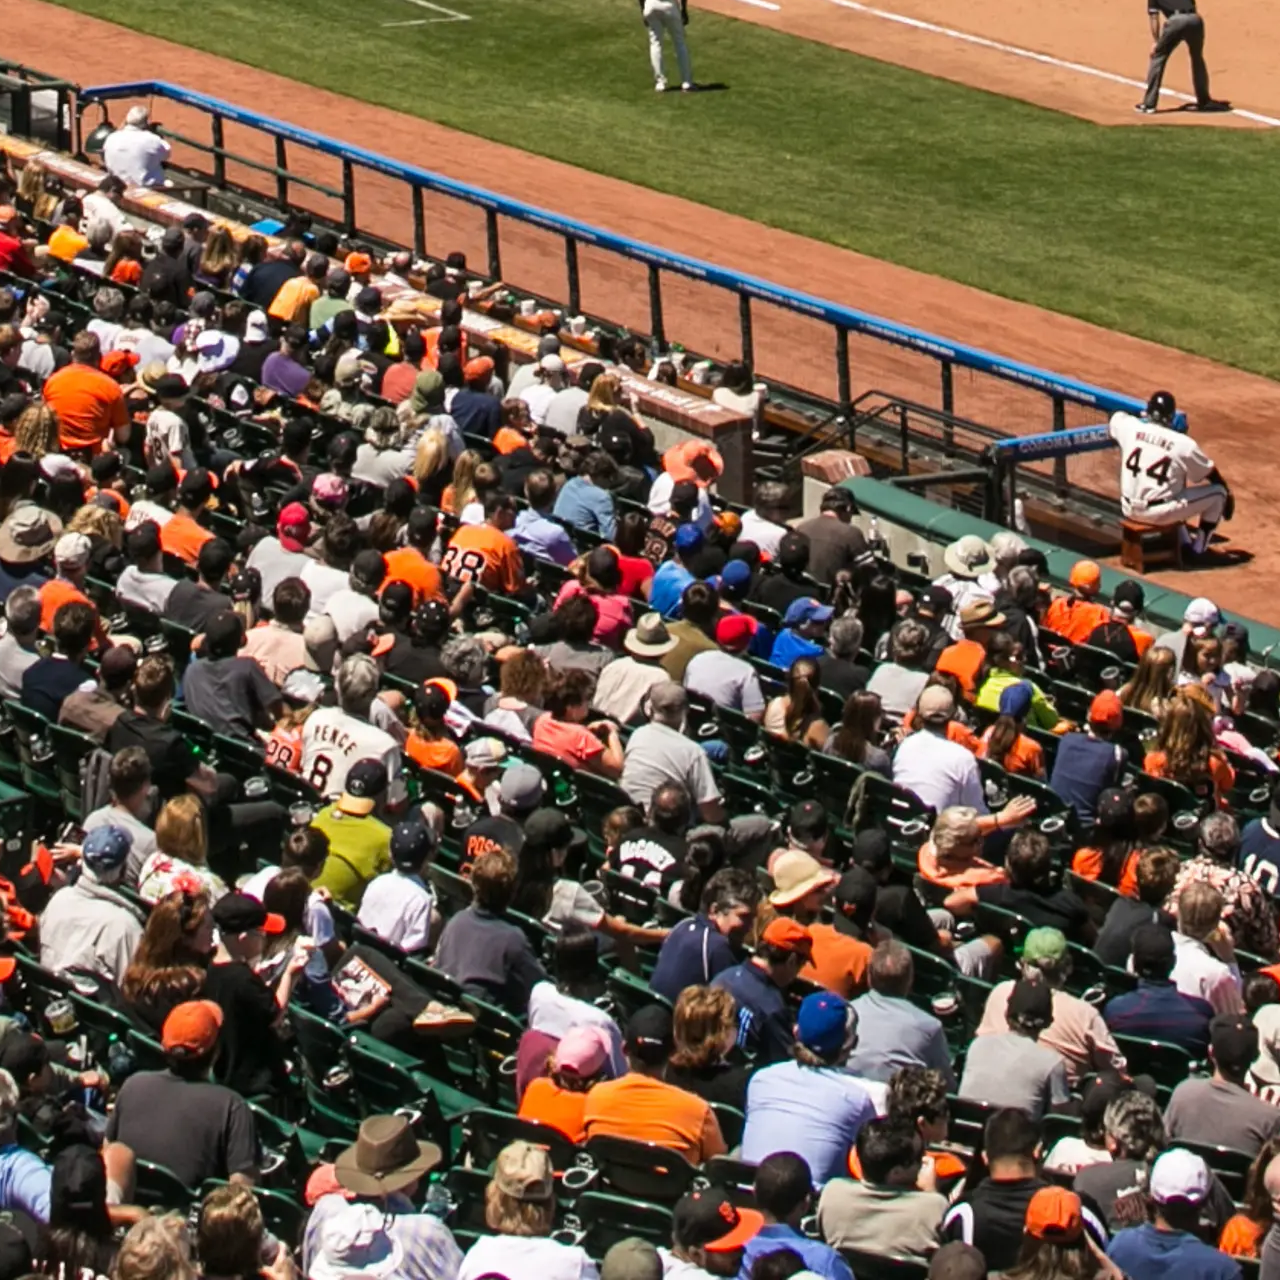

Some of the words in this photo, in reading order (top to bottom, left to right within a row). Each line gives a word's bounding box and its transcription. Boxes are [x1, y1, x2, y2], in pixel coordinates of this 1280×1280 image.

[1125, 446, 1172, 487] 44
[314, 724, 358, 756] PENCE
[309, 753, 334, 792] 8
